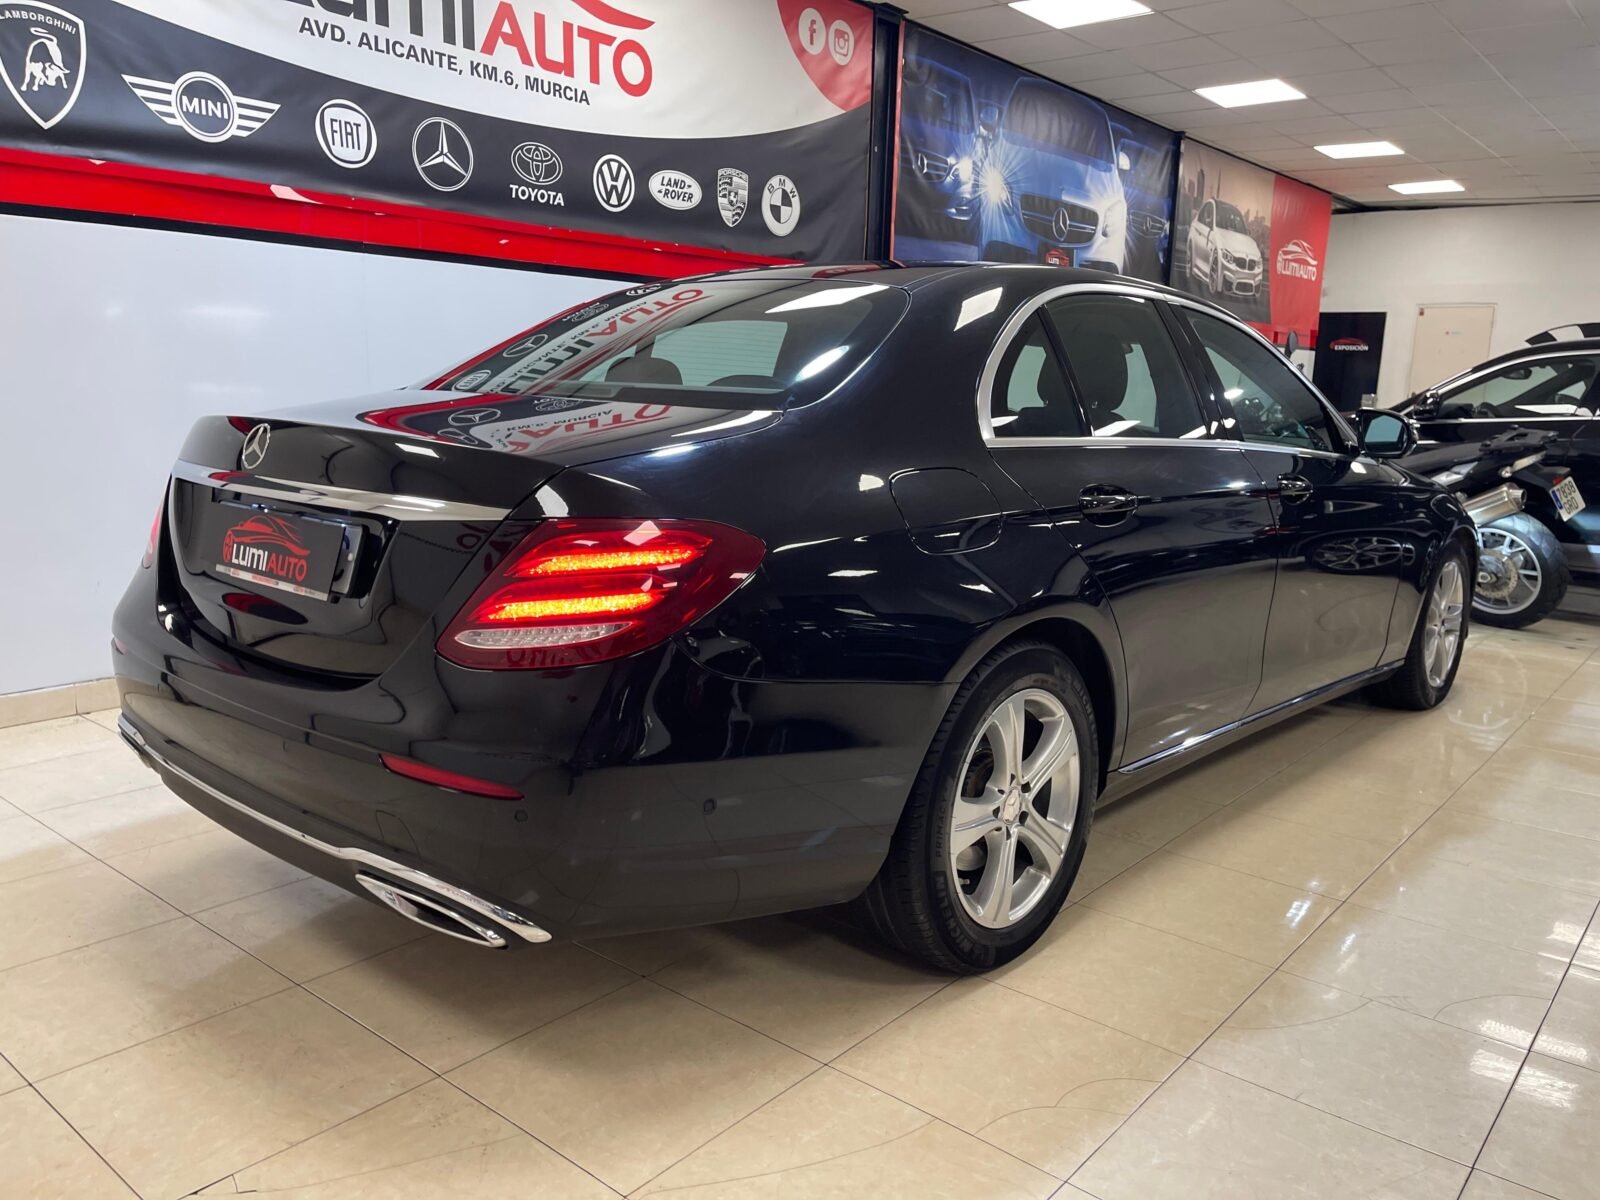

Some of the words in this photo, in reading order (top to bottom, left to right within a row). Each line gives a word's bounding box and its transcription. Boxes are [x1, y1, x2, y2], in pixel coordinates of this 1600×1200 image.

[286, 0, 653, 97] MIAUTO
[299, 17, 351, 45] AVD.
[358, 32, 463, 75] ALICANTE,
[470, 61, 519, 90] KM.6,
[525, 75, 590, 106] MURCIA
[182, 95, 229, 120] MINI
[330, 118, 361, 151] FIAT
[510, 184, 564, 206] TOYOTA
